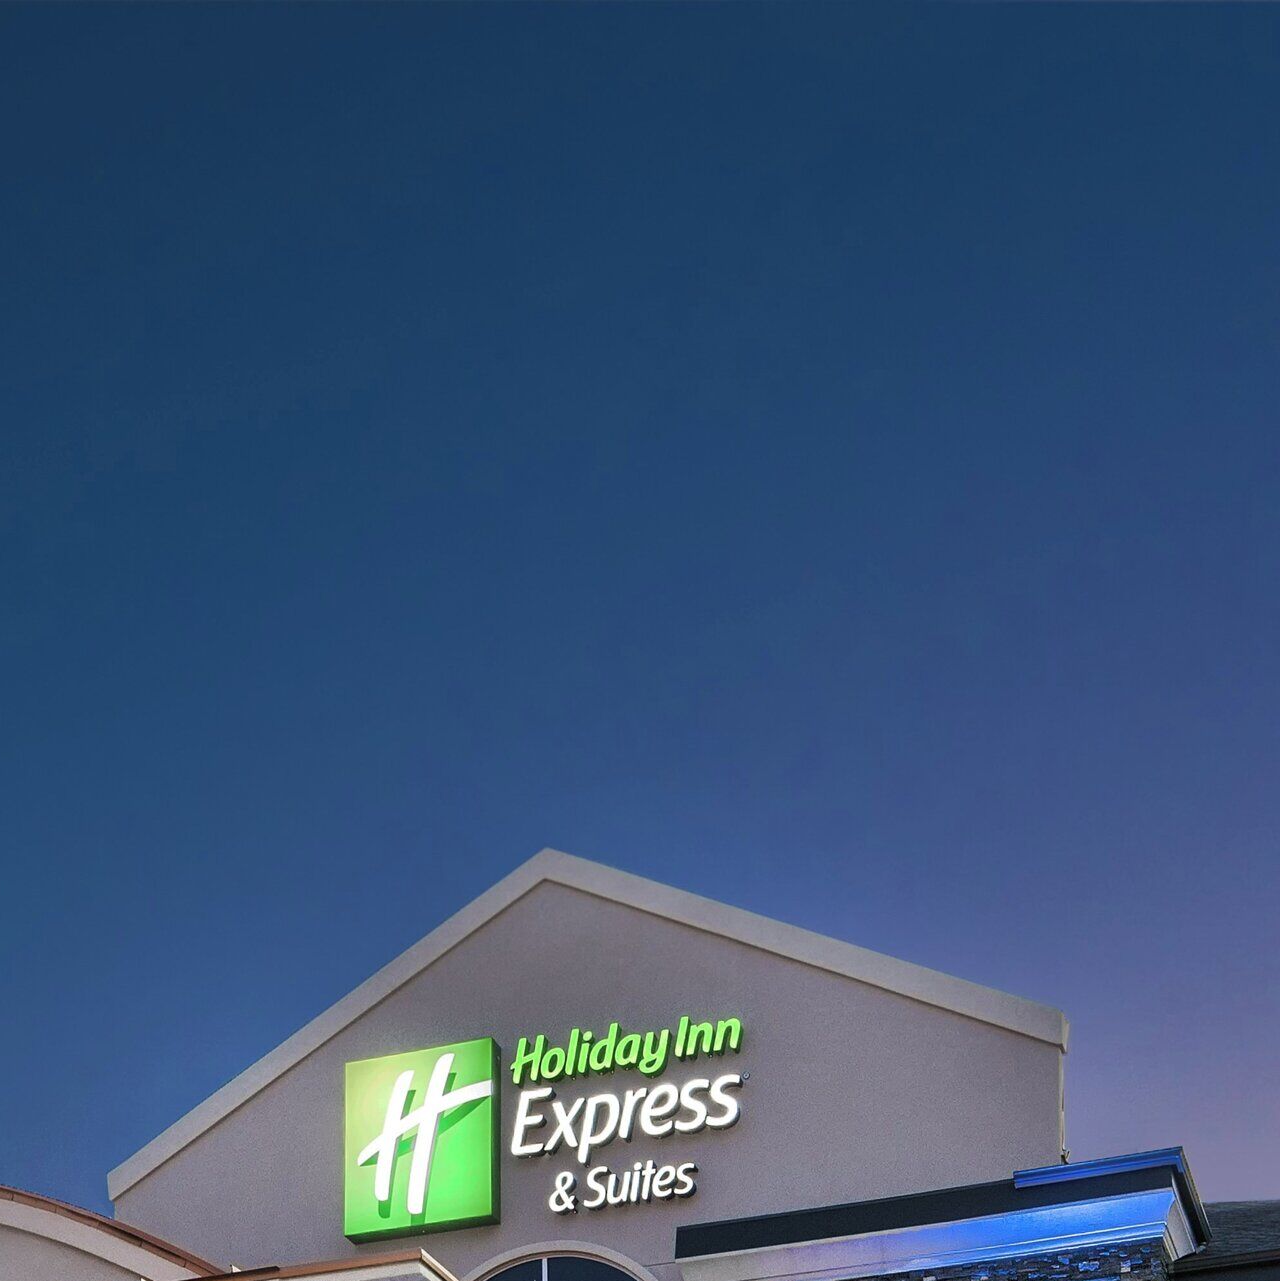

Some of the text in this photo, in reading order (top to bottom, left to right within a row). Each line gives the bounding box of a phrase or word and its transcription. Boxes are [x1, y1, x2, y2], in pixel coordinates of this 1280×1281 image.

[510, 1016, 741, 1084] Holiday Inn
[511, 1074, 741, 1164] Express
[549, 1160, 696, 1213] & Suites
